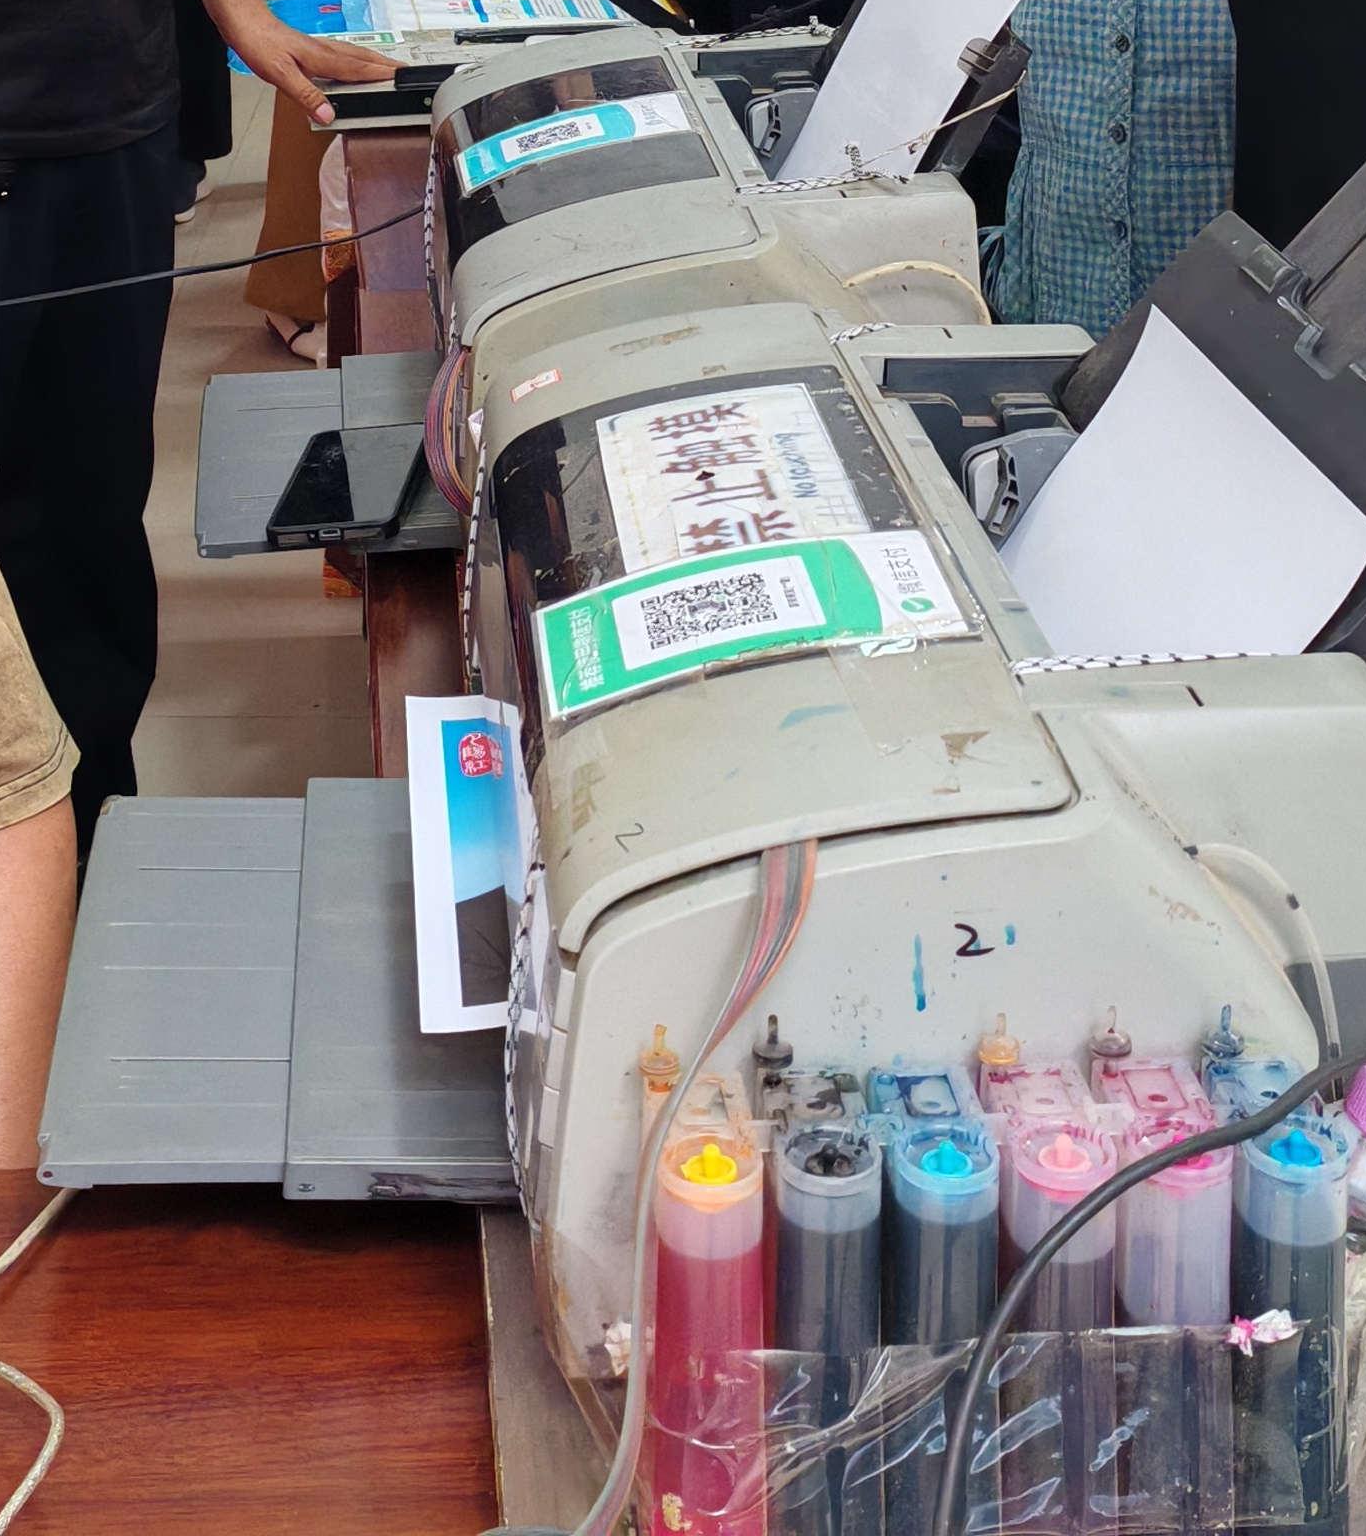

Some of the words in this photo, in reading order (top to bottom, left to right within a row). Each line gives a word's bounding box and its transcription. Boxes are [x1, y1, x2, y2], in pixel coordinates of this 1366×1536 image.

[879, 545, 928, 595] 微信支付
[953, 922, 996, 957] 2
